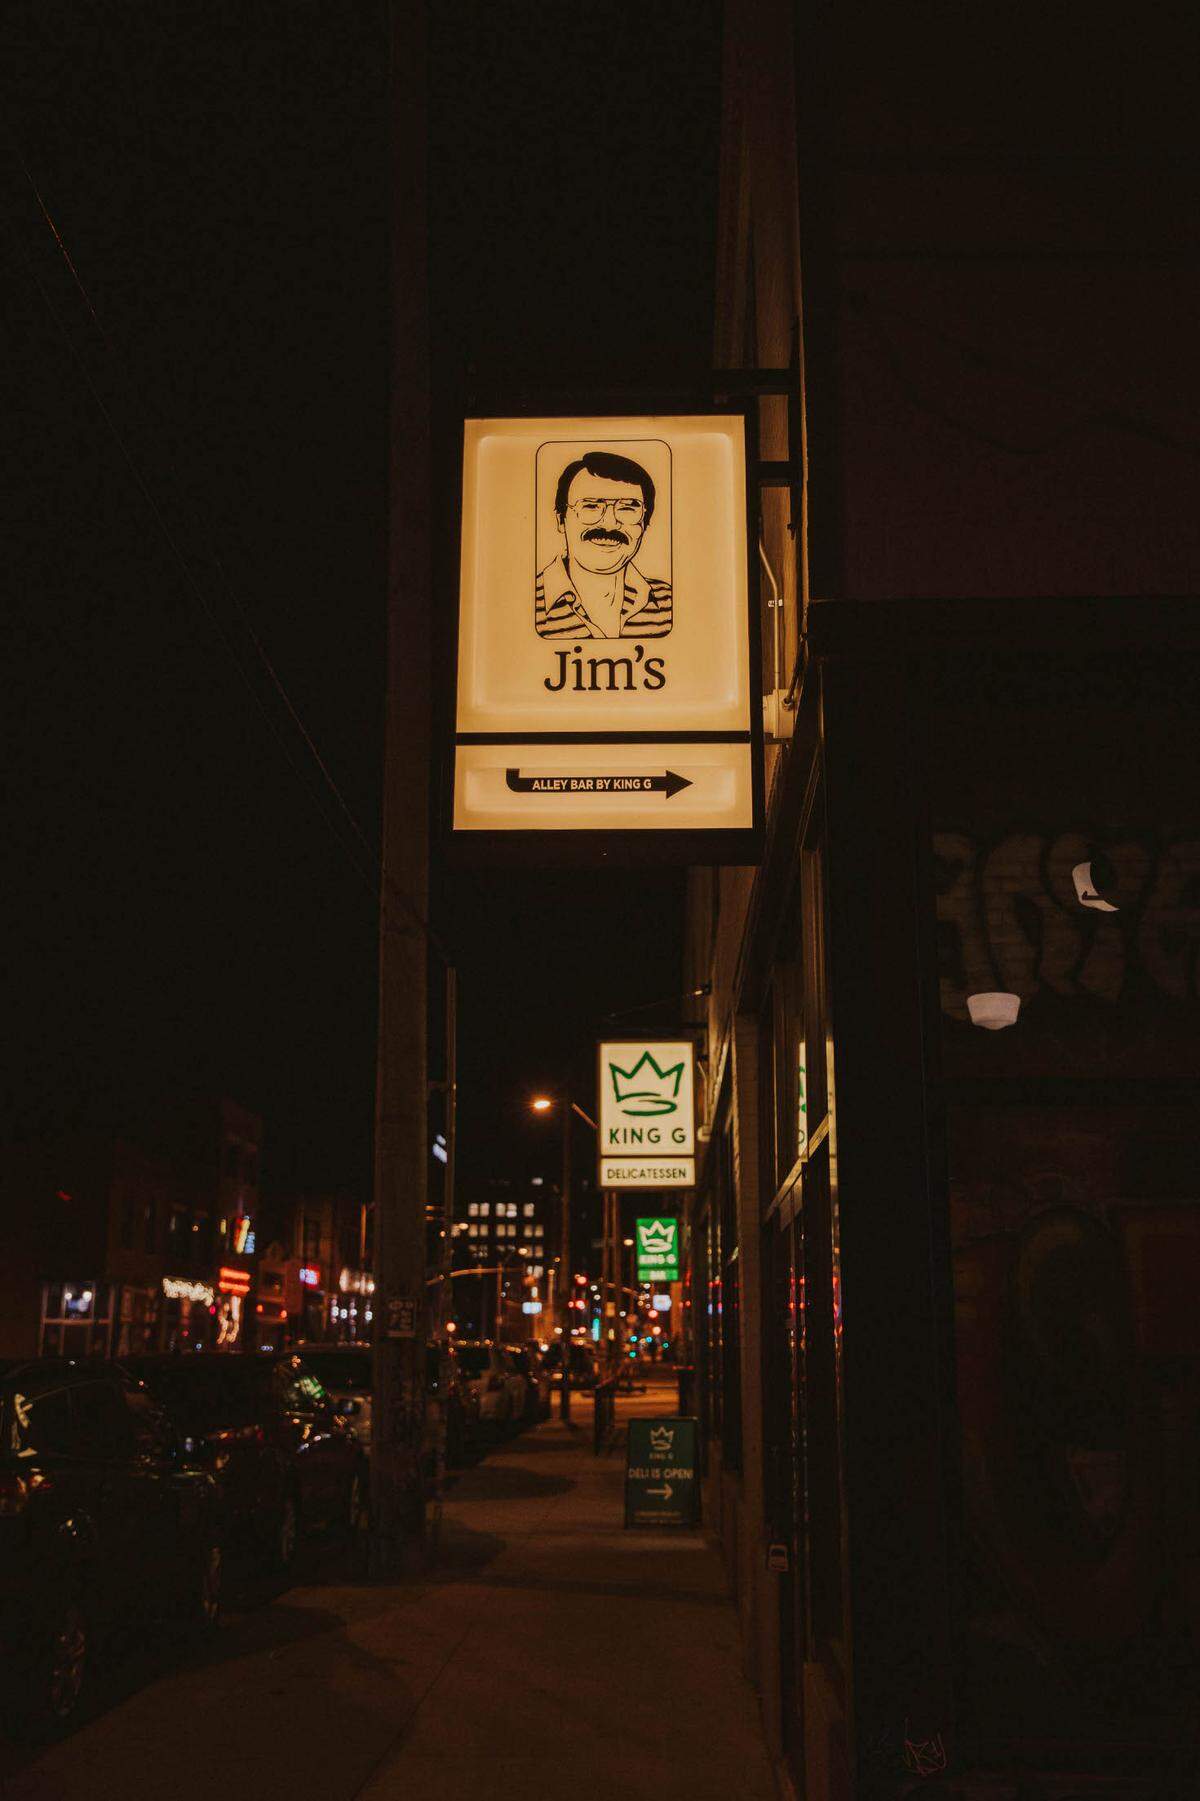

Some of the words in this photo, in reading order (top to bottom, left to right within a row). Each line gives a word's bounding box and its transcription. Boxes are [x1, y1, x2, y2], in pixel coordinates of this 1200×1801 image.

[544, 645, 666, 691] Jim's
[532, 779, 568, 790] ALLEY
[570, 779, 593, 790] BAR
[597, 779, 611, 790] BY
[614, 779, 641, 790] KING
[643, 779, 652, 790] G
[609, 1128, 661, 1144] KING
[672, 1128, 686, 1144] G
[607, 1168, 686, 1180] DELICATESSEN
